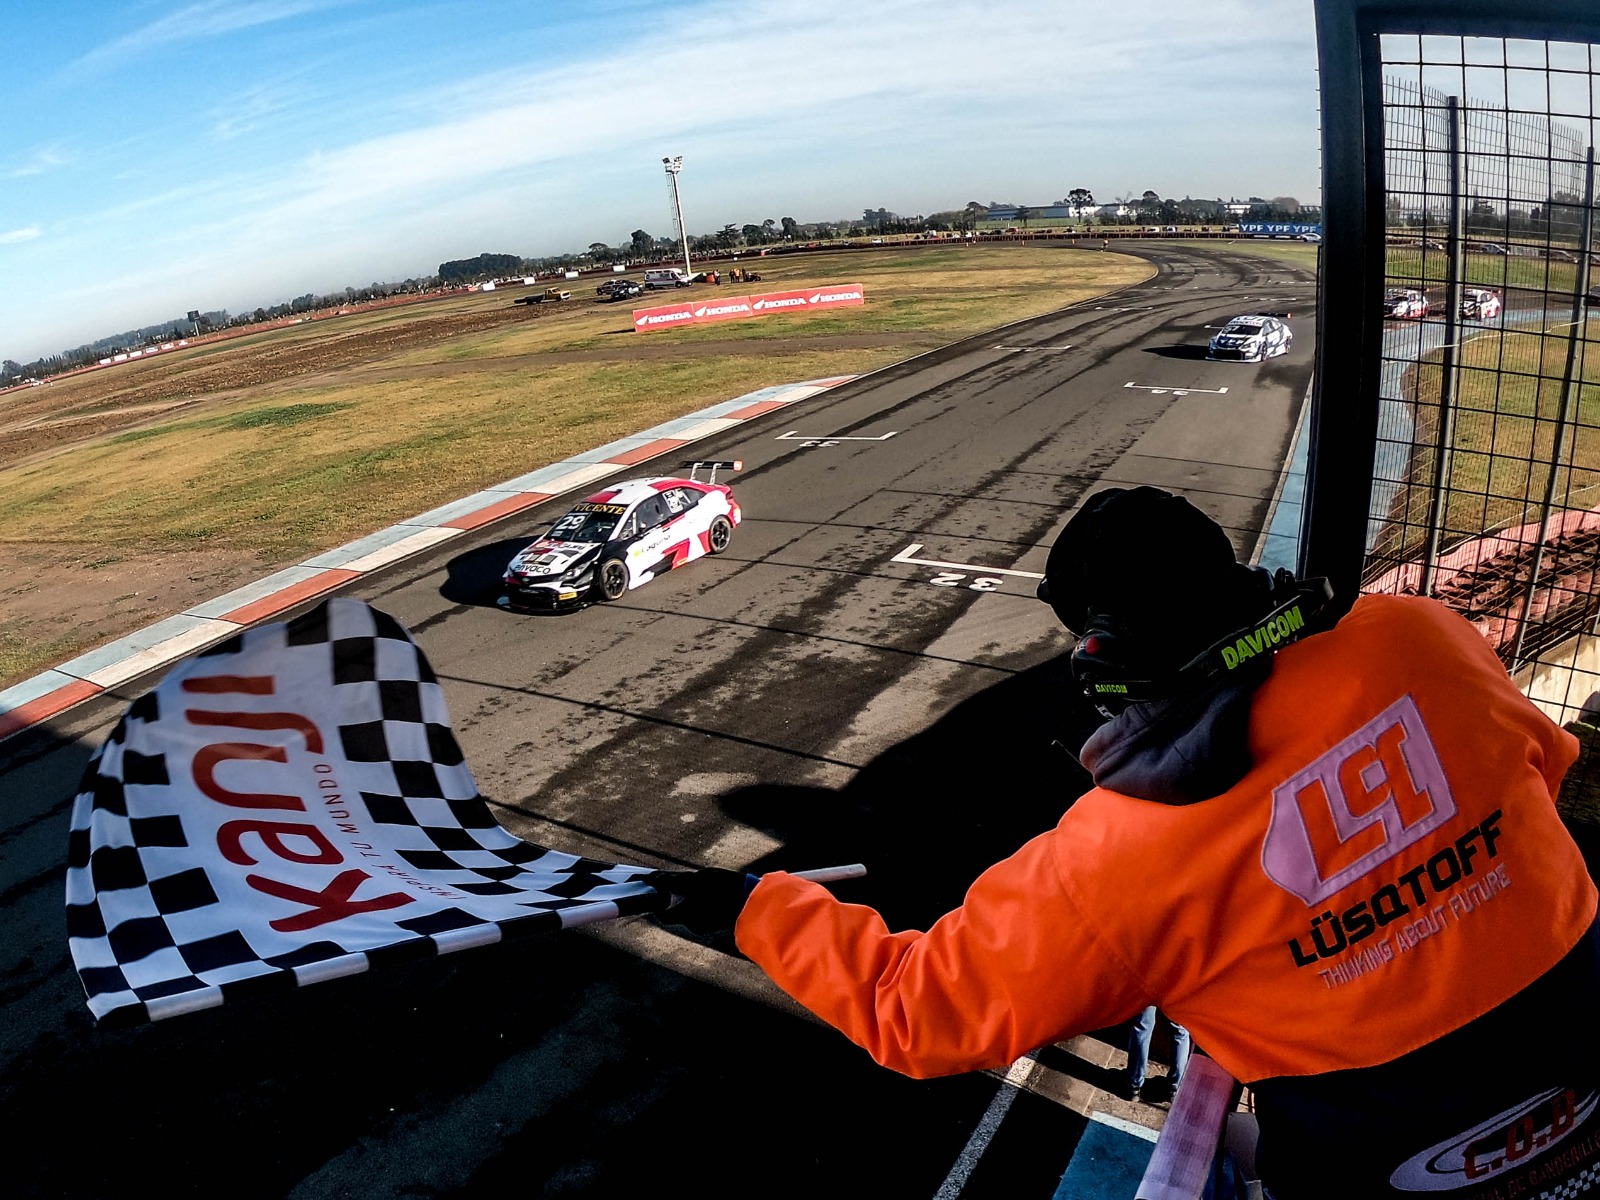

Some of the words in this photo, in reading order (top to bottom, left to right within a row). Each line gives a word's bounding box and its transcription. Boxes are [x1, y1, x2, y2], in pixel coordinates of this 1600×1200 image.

[1241, 224, 1263, 232] YPF
[1266, 224, 1290, 232] YPF
[1293, 225, 1316, 233] YPF
[764, 297, 807, 309] HONDA
[820, 291, 861, 302] HONDA
[707, 303, 750, 315] HONDA
[648, 311, 692, 324] HONDA
[574, 502, 626, 515] VICENTE
[555, 515, 586, 530] 29
[929, 571, 1004, 592] 32
[1221, 605, 1305, 670] DAVICOM
[1095, 683, 1128, 694] DAVICOM
[312, 763, 360, 834] MUNDO
[350, 841, 380, 858] TU
[371, 863, 468, 900] INSPIRA
[1318, 937, 1395, 990] THINKING
[1395, 904, 1450, 953] ABOUT
[1449, 862, 1512, 921] FUTURE
